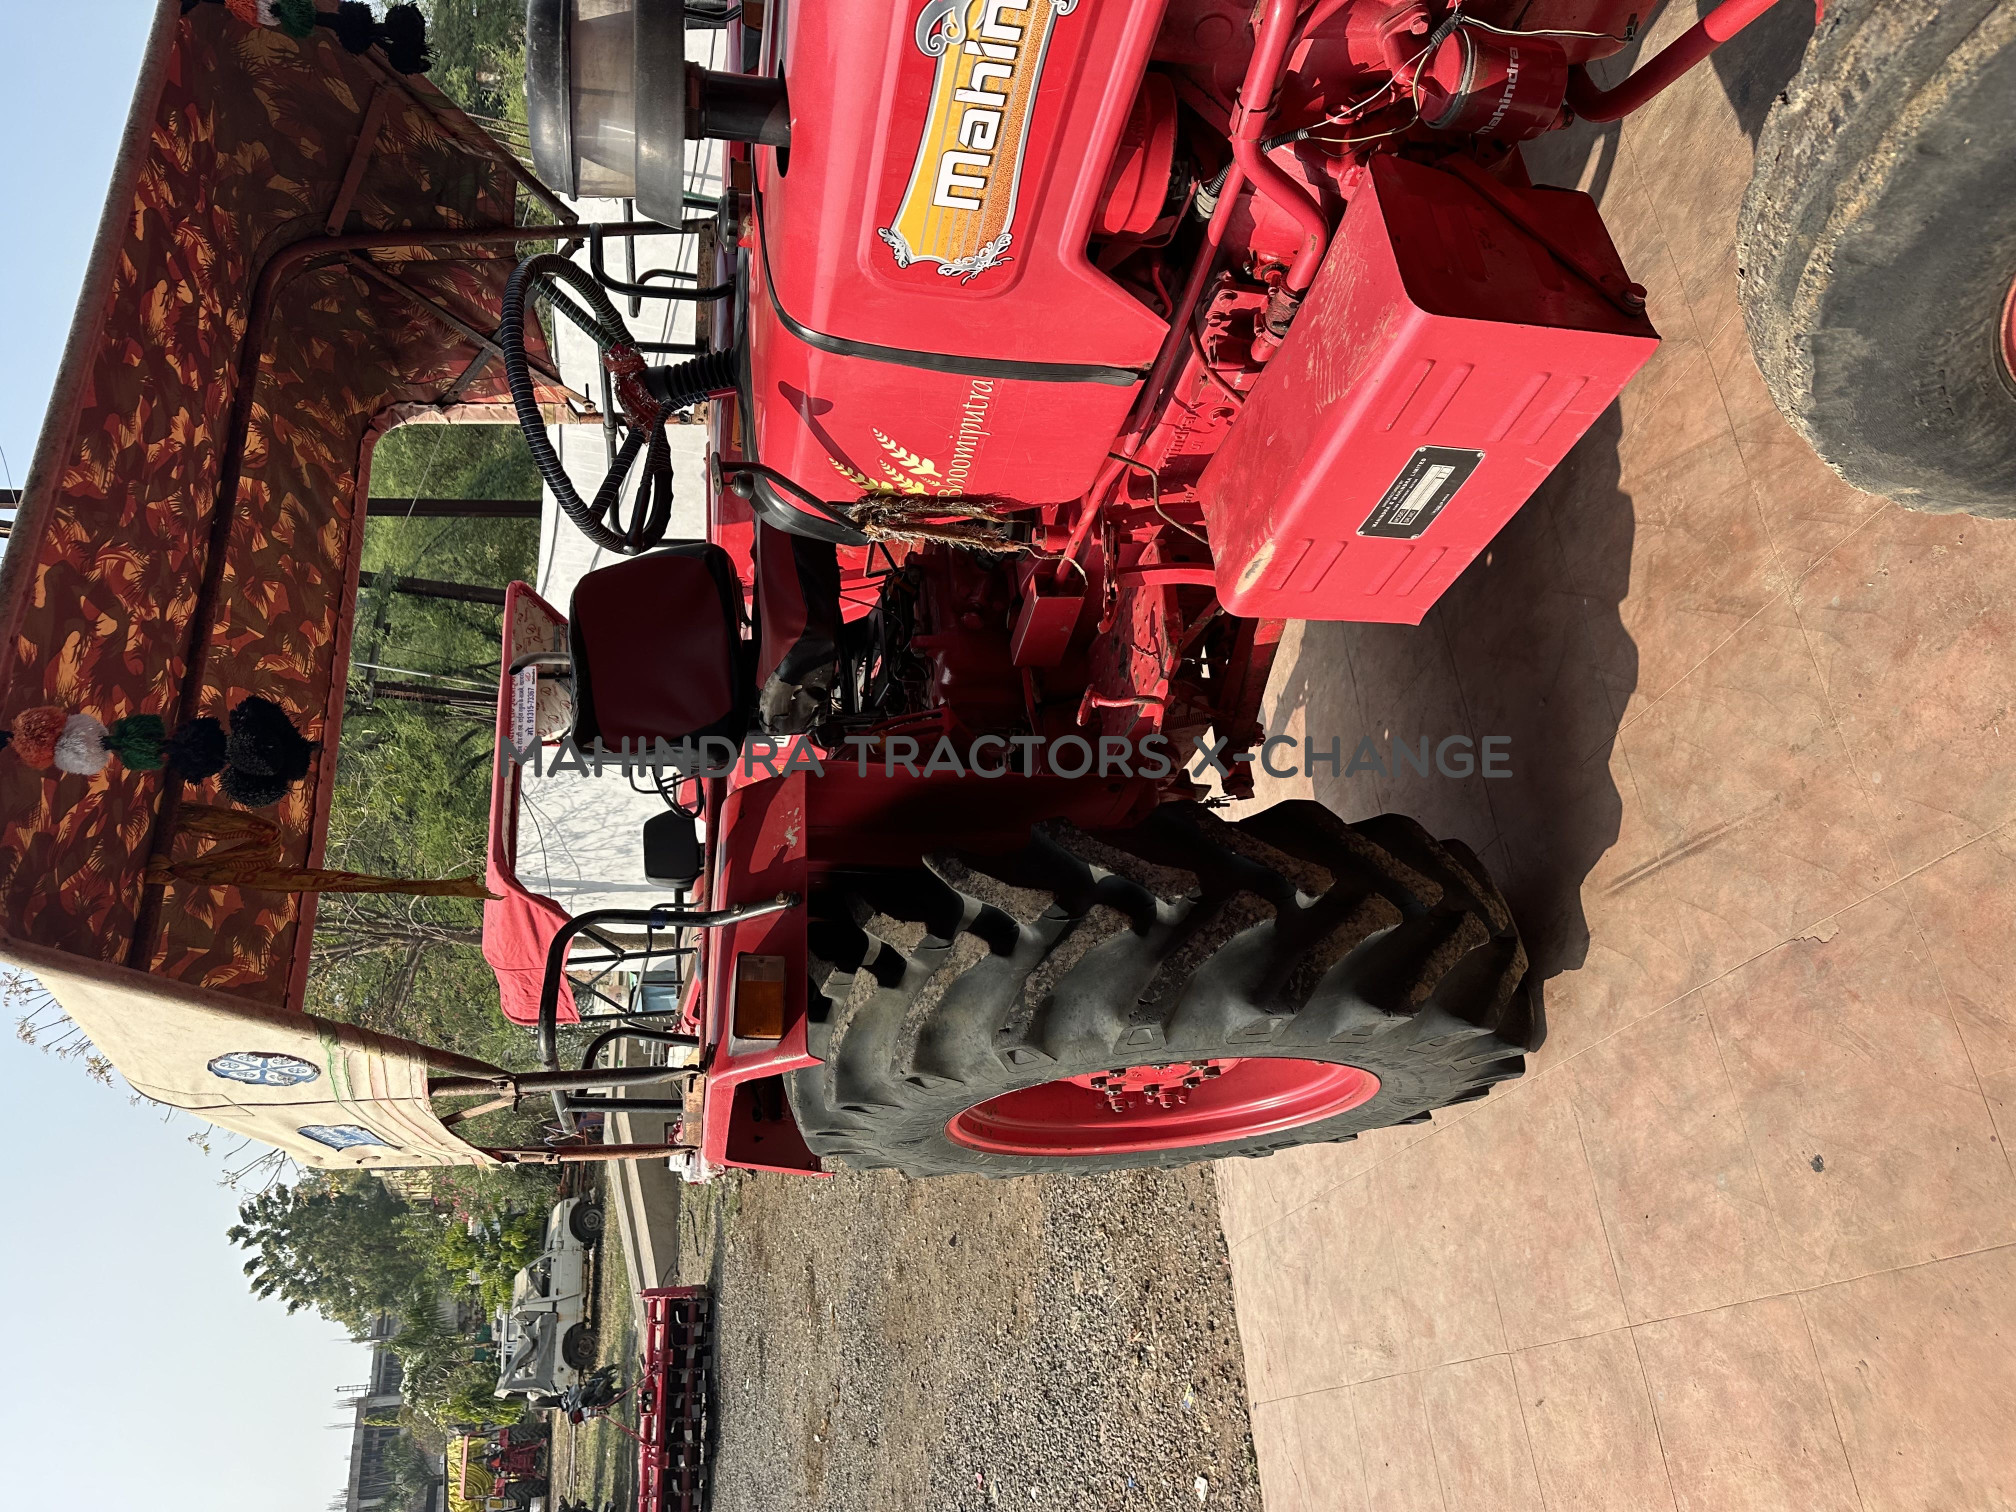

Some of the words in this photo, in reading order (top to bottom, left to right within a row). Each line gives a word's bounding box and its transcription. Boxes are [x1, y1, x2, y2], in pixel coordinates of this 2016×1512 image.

[1475, 46, 1519, 135] Mahindra
[936, 379, 995, 499] Bhoomiputra
[1371, 506, 1392, 528] MAHINDRA
[1391, 477, 1412, 501] MAHINDRA
[1409, 458, 1427, 477] LIMITED
